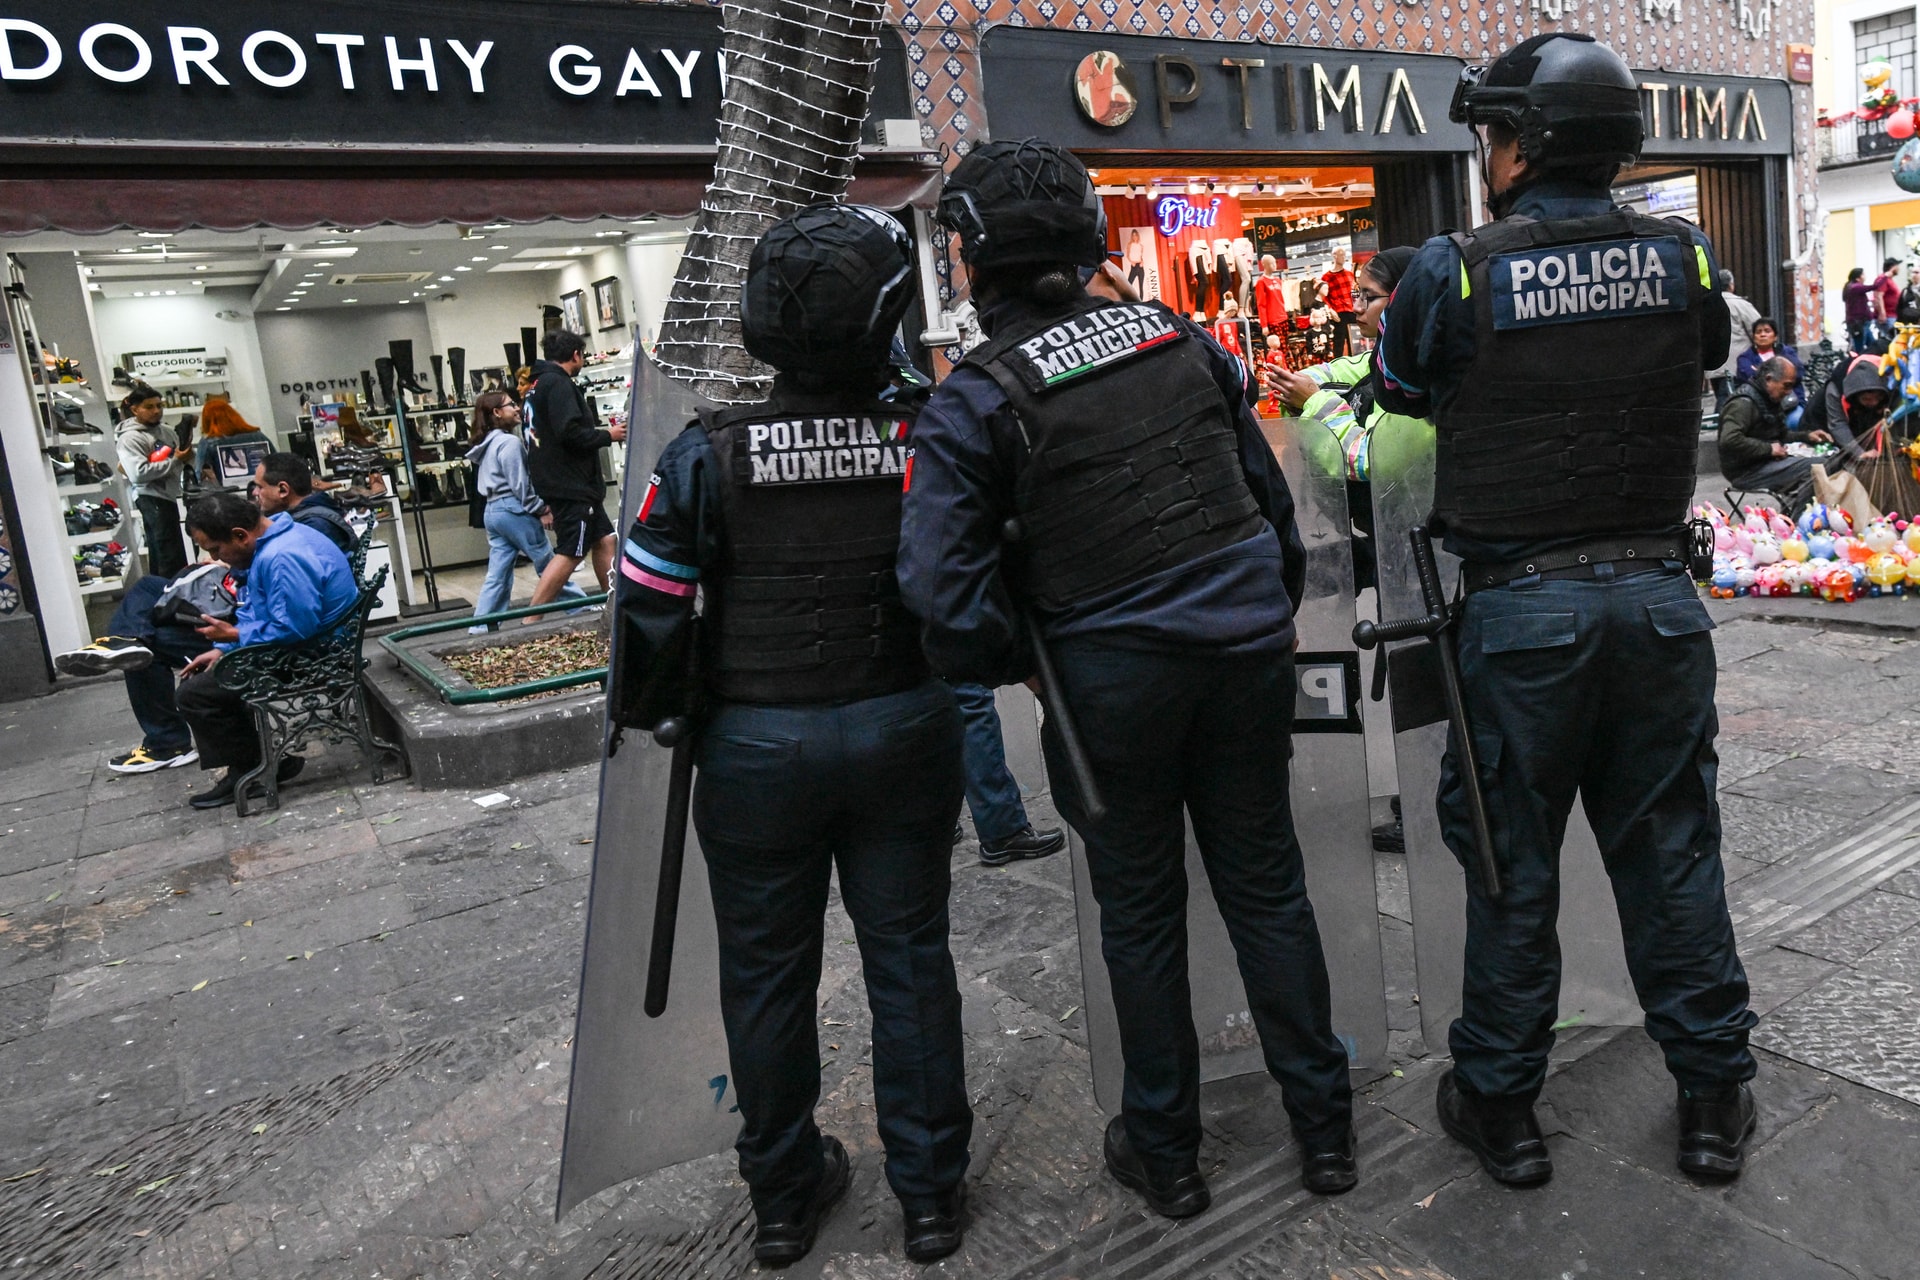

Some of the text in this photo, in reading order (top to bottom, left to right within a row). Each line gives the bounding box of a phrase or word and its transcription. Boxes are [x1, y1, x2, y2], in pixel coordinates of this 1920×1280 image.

[0, 18, 726, 98] DOROTHY GAY
[1641, 82, 1767, 141] TIMA
[1148, 268, 1160, 299] KINNY
[1510, 243, 1667, 292] POLICÍA
[1513, 279, 1669, 321] MUNICIPAL
[1019, 305, 1160, 359] POLICIA
[1033, 315, 1173, 378] MUNICIPAL
[280, 377, 358, 394] DOROTHY
[747, 417, 881, 452] POLICIA
[750, 446, 907, 483] MUNICIPAL
